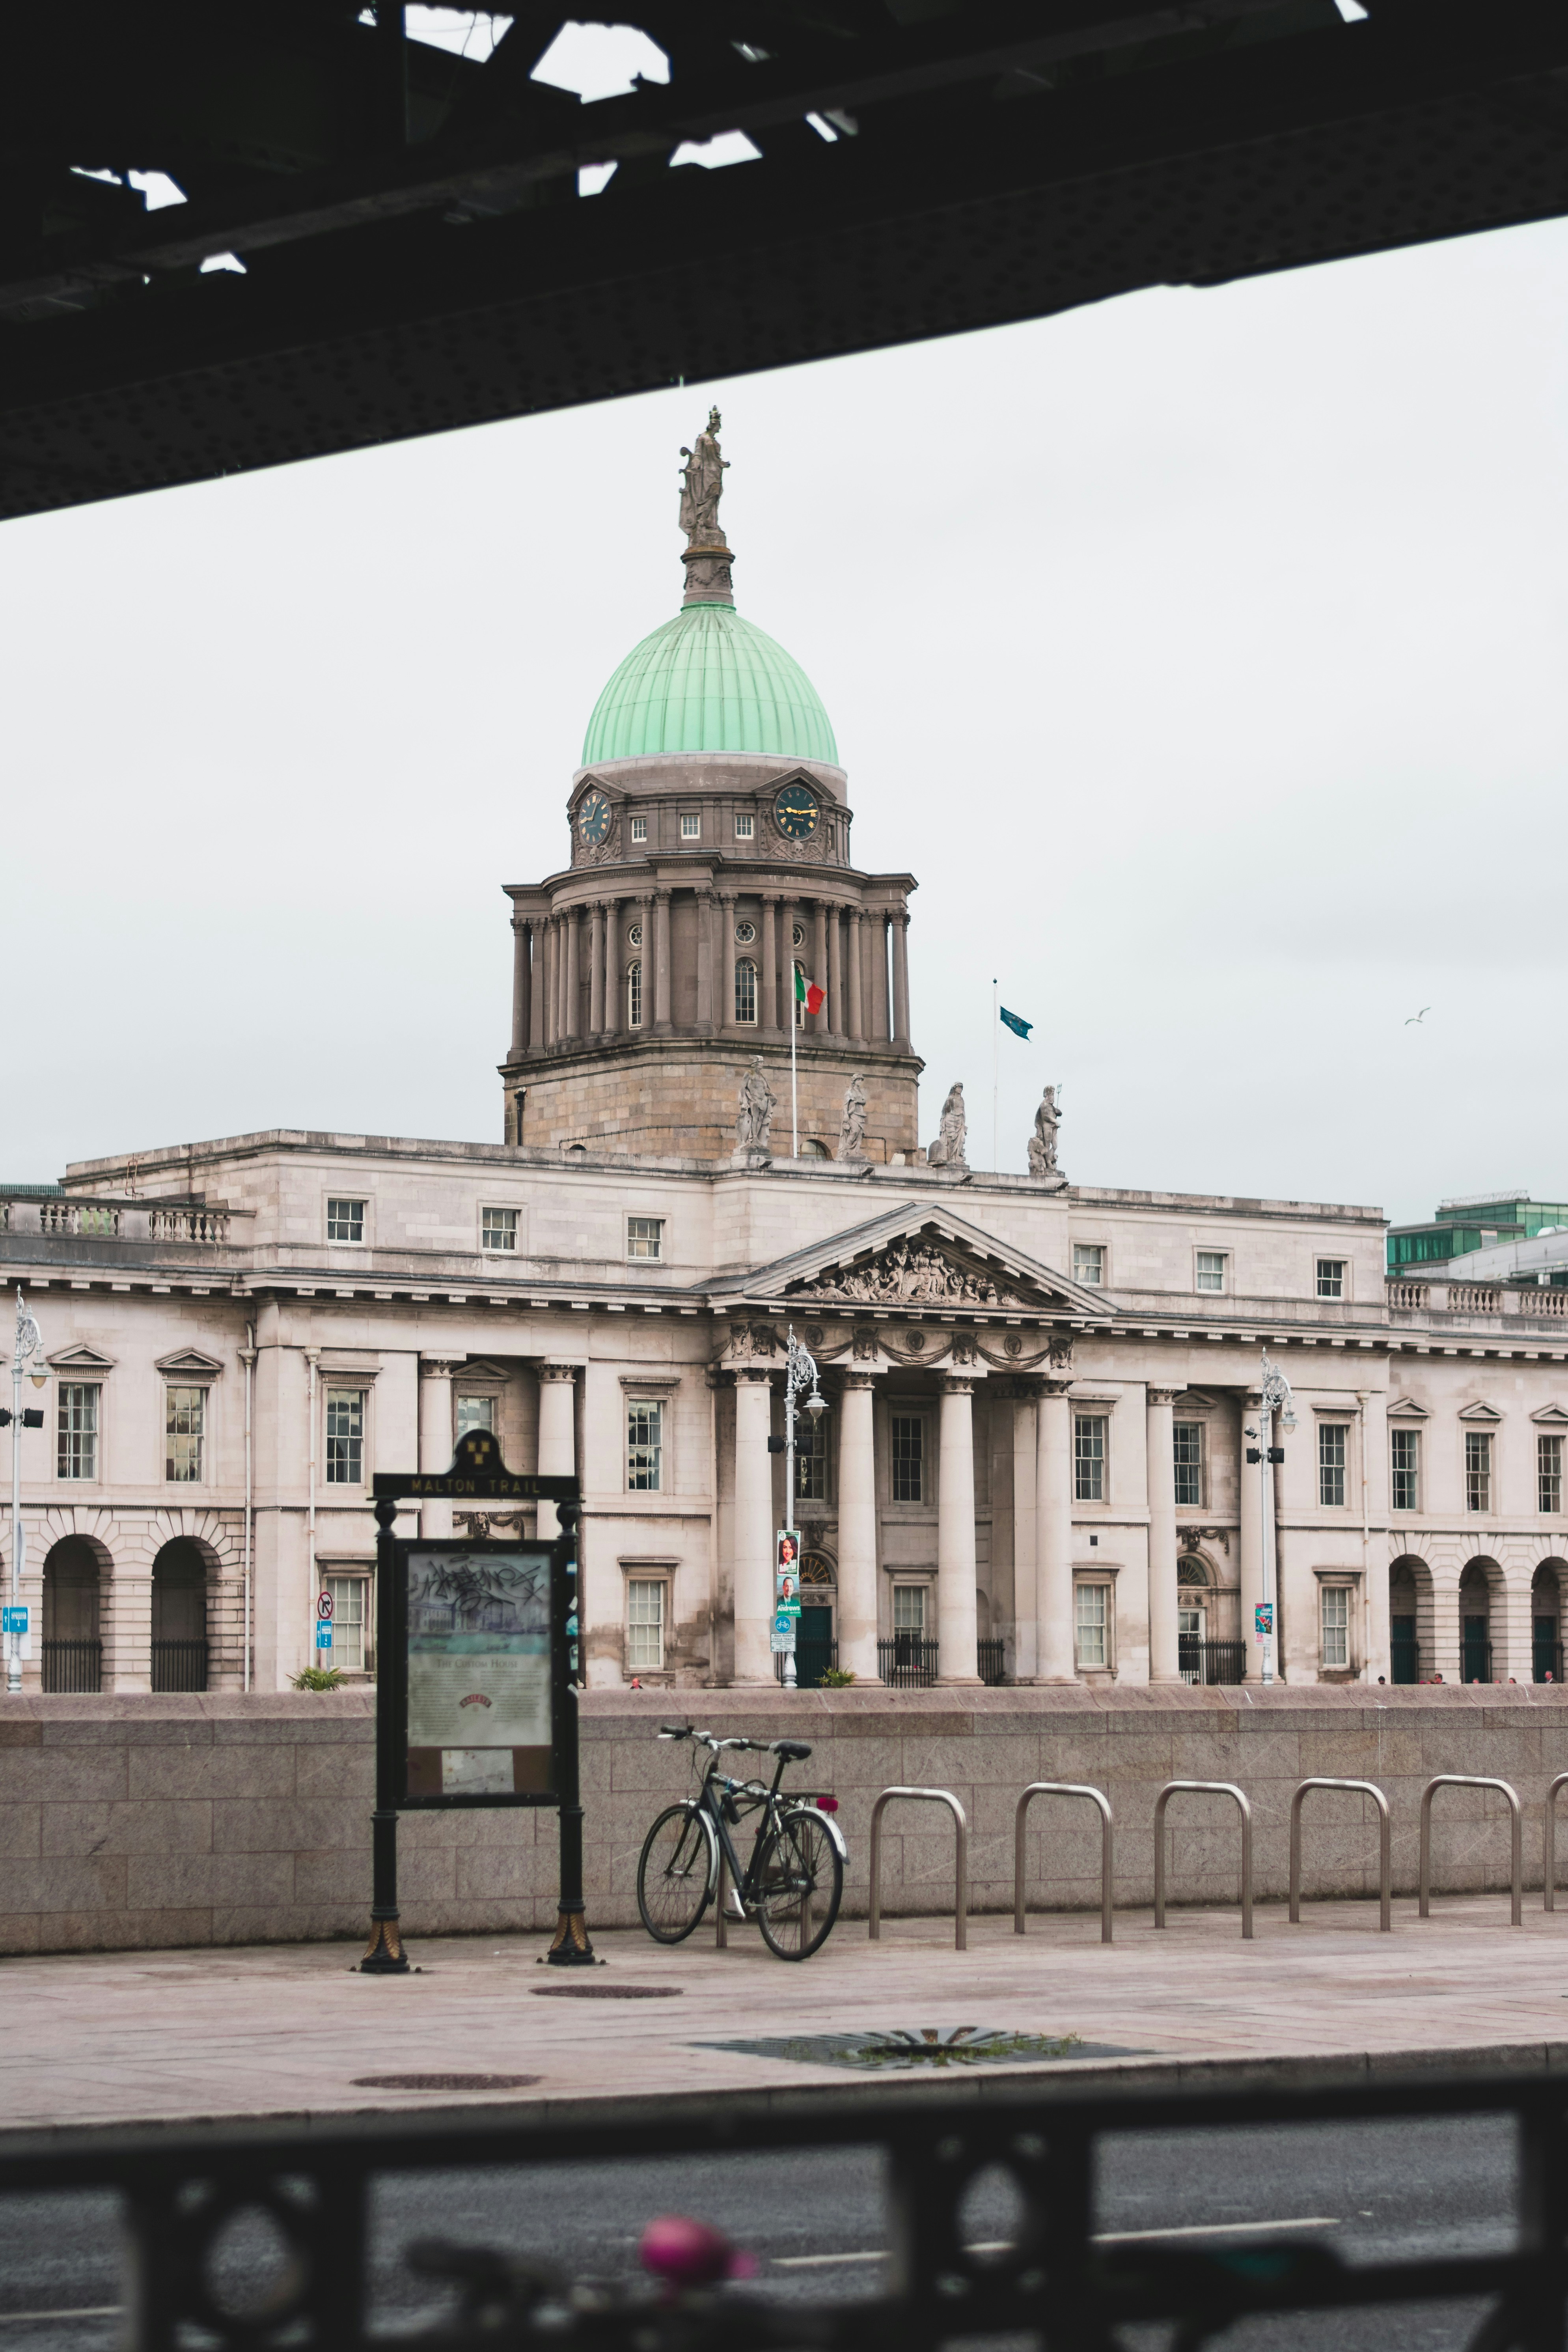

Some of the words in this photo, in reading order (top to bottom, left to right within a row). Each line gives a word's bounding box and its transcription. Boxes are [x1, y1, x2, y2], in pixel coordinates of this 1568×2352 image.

[412, 1478, 475, 1492] MALTON
[490, 1479, 541, 1494] TRAIL
[461, 1694, 491, 1707] BAILEYS
